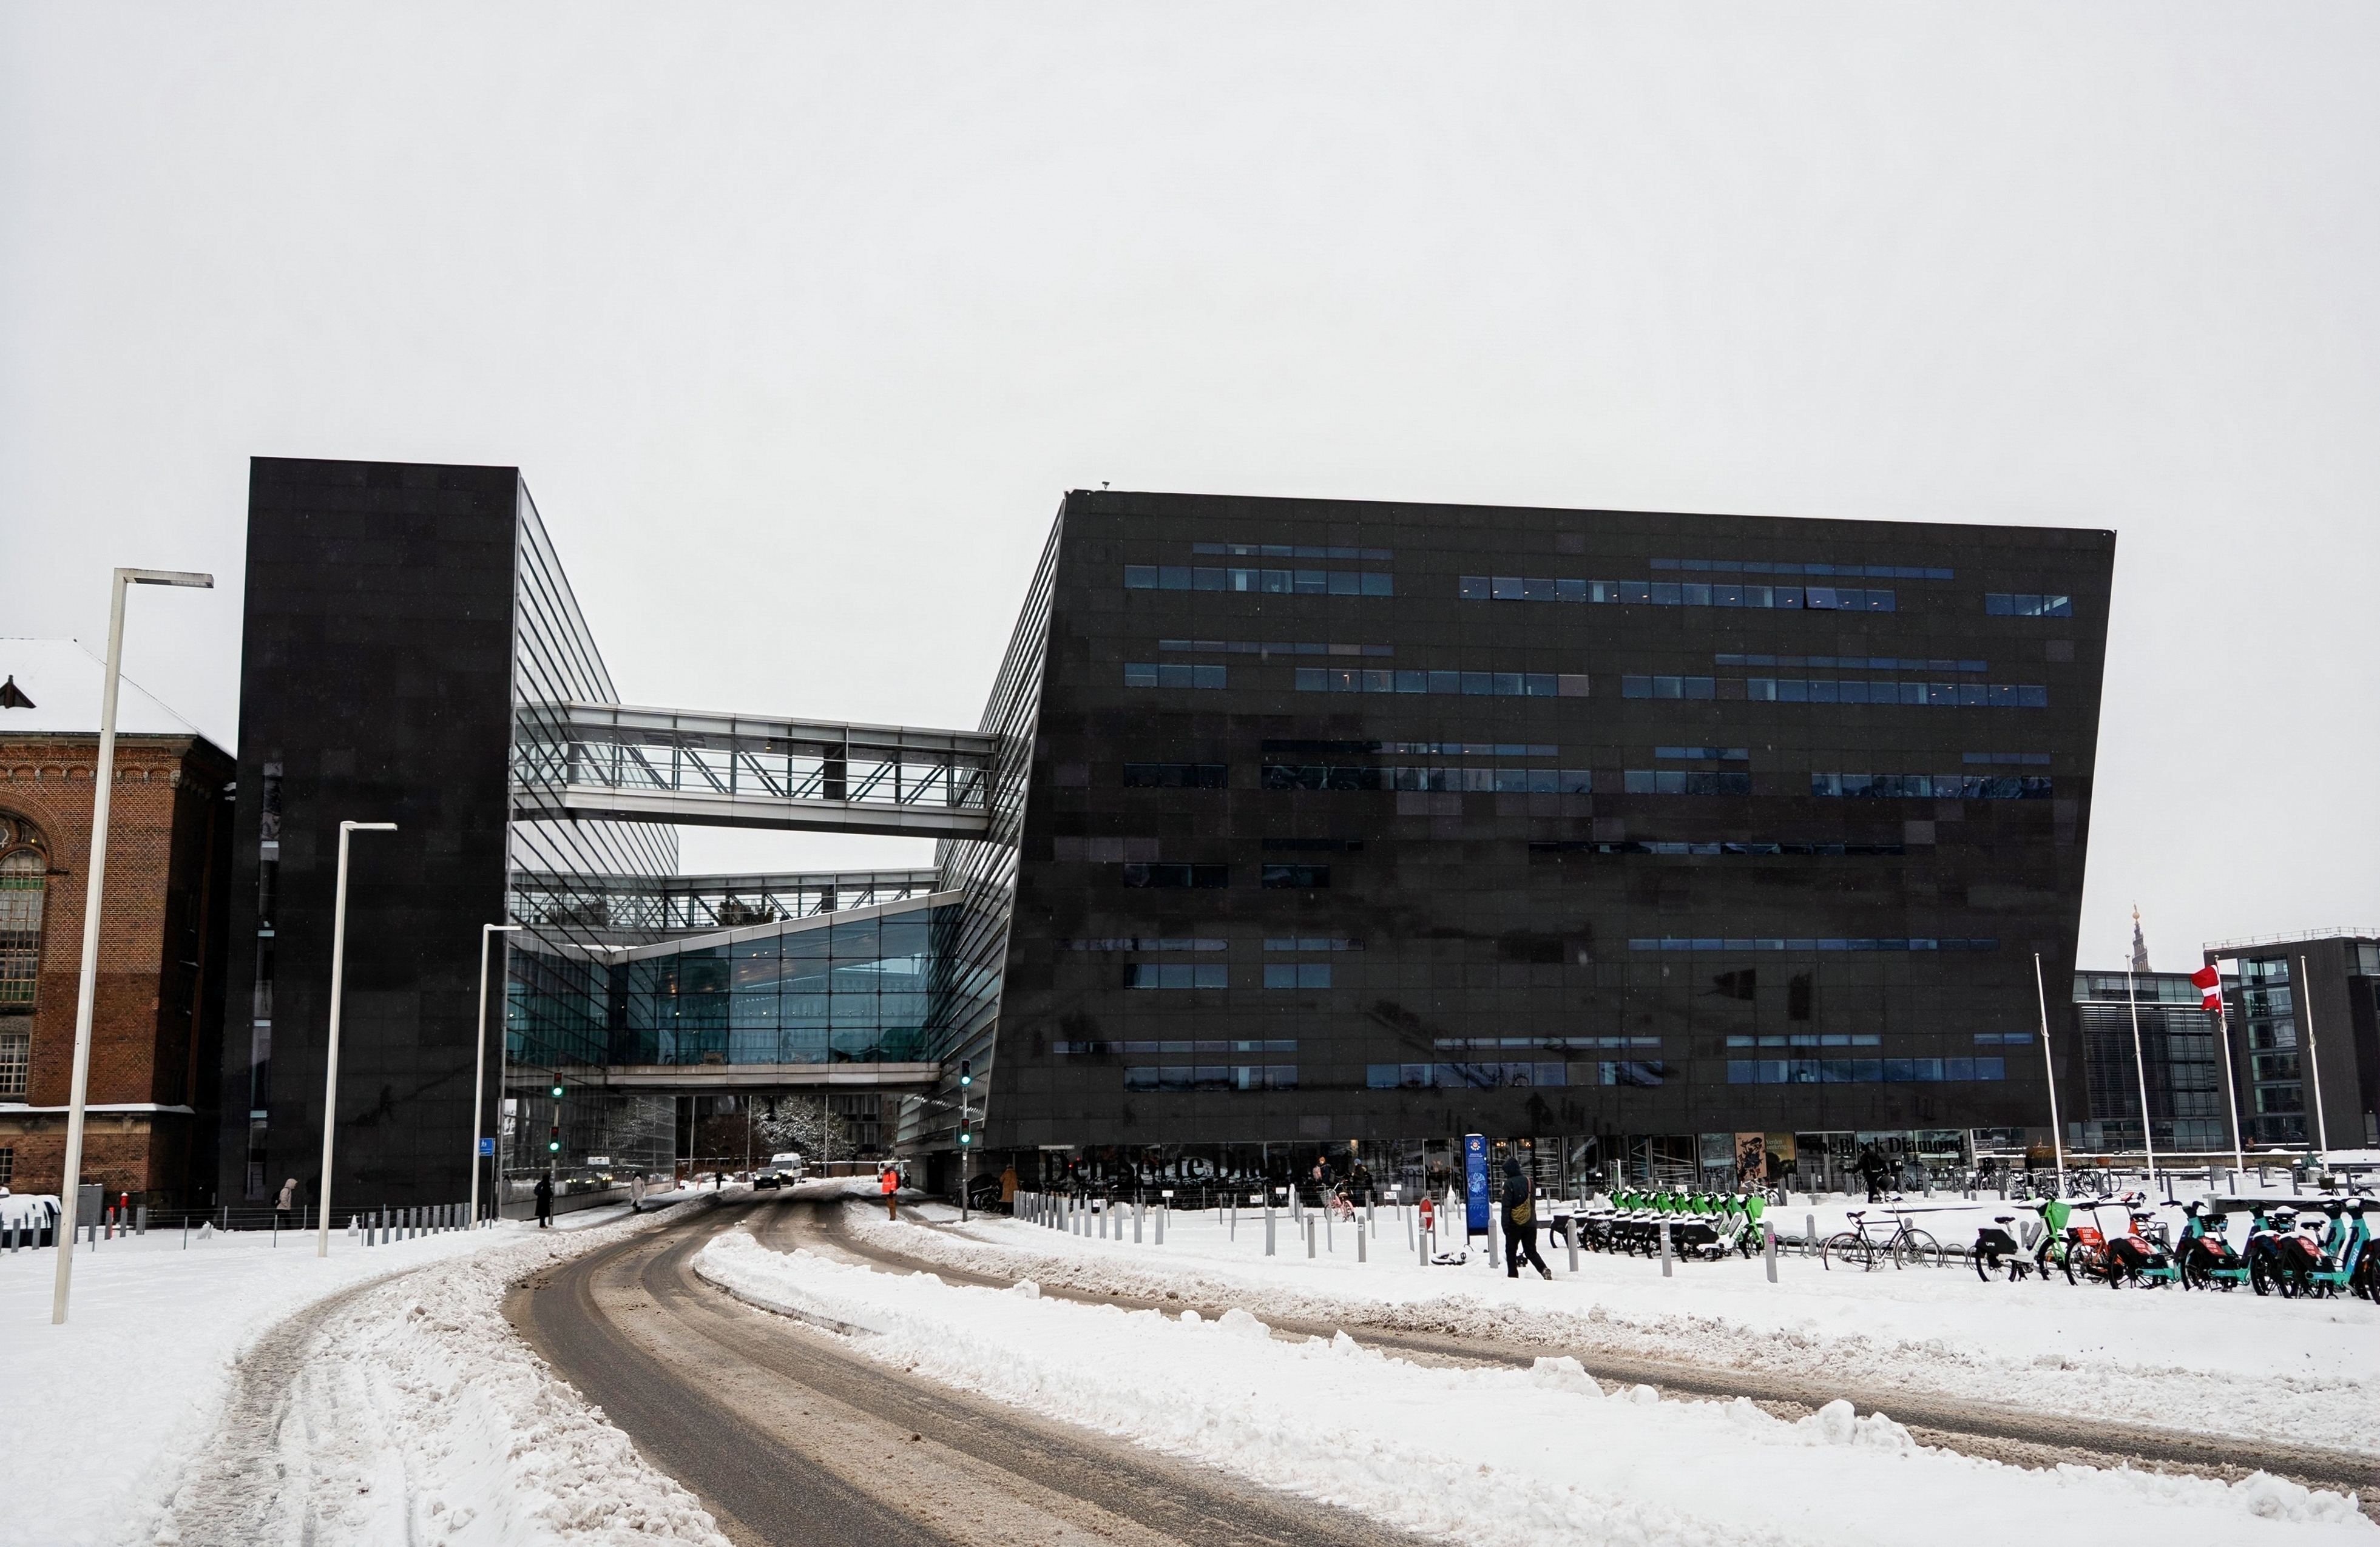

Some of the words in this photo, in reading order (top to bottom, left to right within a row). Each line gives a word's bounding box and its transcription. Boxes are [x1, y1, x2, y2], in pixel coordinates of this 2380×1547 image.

[1839, 1136, 1885, 1154] Black
[1888, 1135, 1965, 1153] Diamond
[1044, 1153, 1105, 1181] Den
[1115, 1152, 1203, 1182] Sorte
[2351, 1248, 2360, 1266] dott
